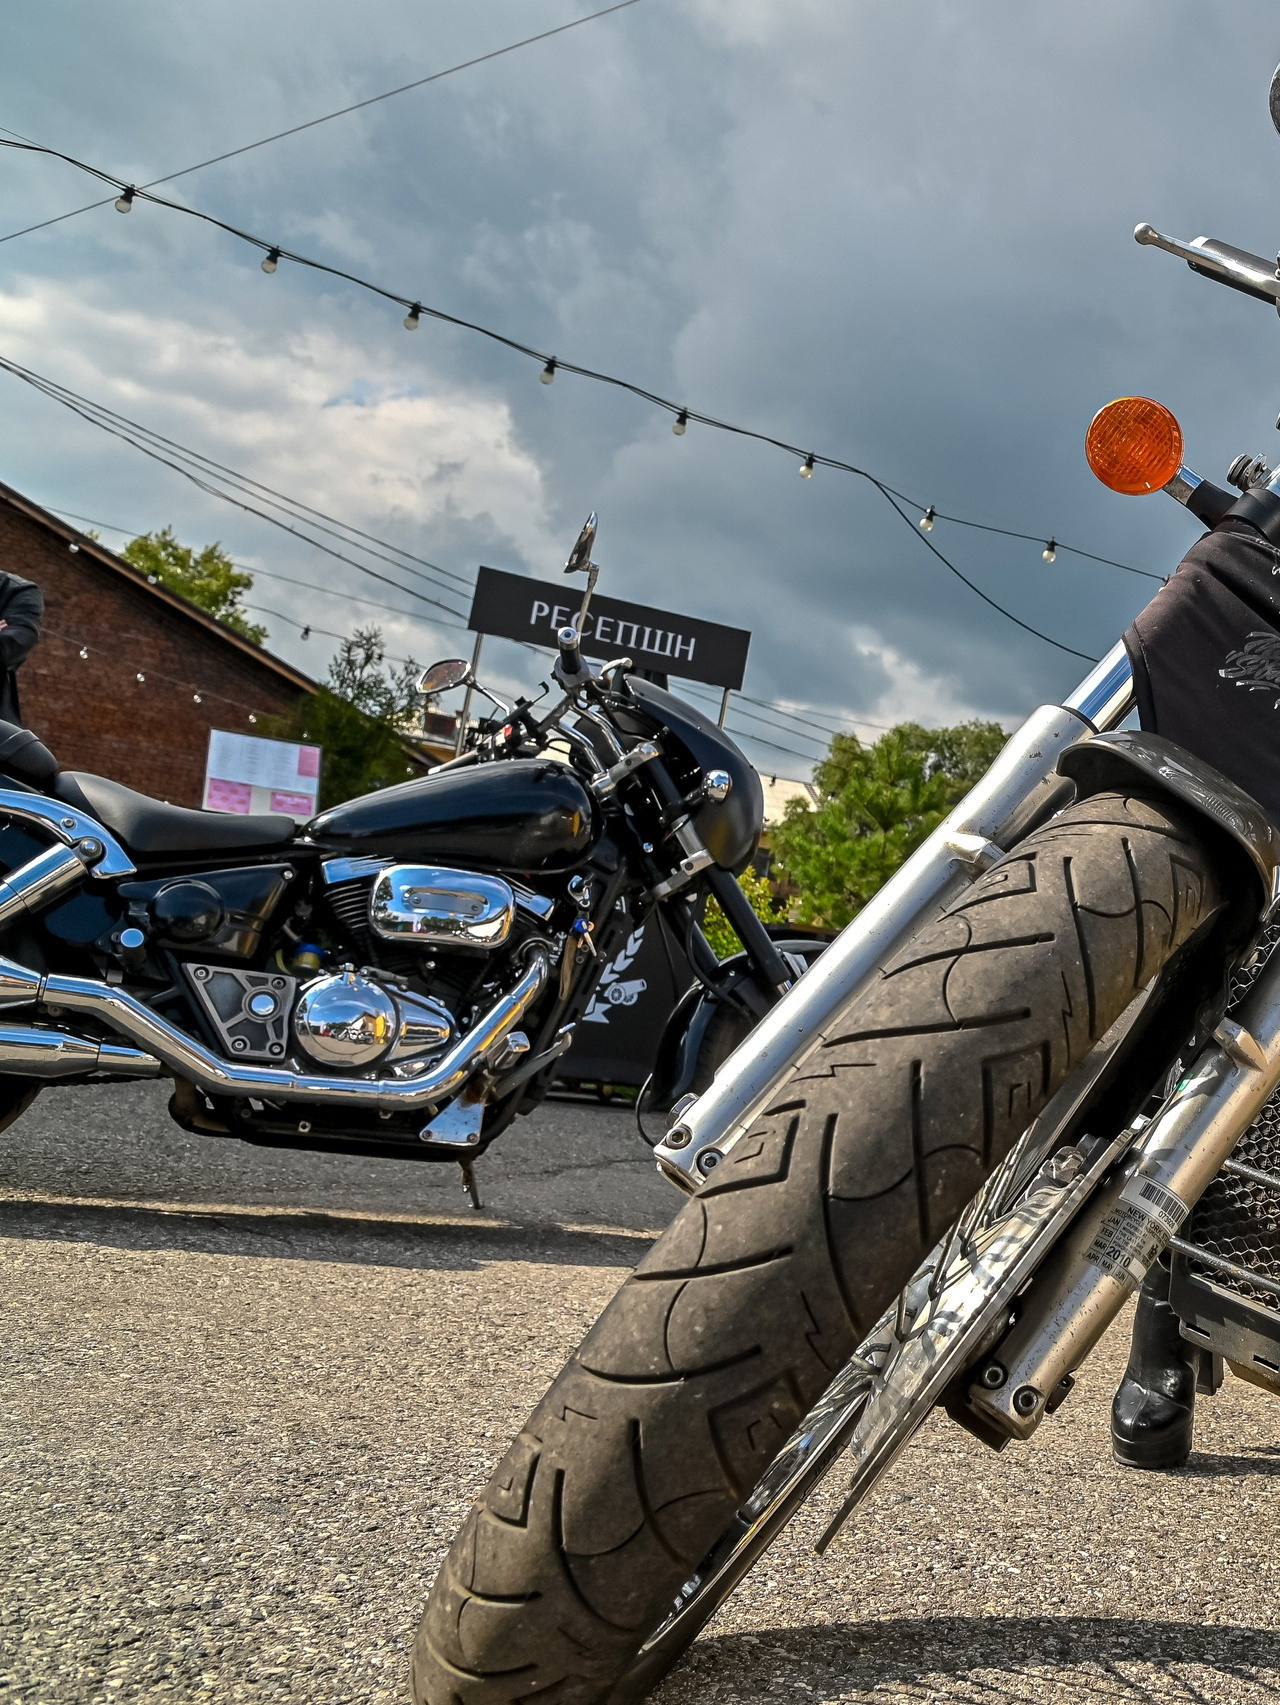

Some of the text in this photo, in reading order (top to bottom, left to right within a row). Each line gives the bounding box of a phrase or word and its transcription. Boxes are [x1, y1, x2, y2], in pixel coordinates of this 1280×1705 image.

[529, 600, 696, 662] РЕСЕПШН
[1108, 1215, 1121, 1227] JAN
[1127, 1206, 1147, 1223] NEW
[1147, 1218, 1164, 1237] YORK
[1101, 1227, 1114, 1238] FEB
[1094, 1239, 1108, 1251] MAR
[1086, 1252, 1099, 1264] APR
[1106, 1246, 1131, 1268] 2010
[1102, 1260, 1114, 1271] MAY
[1115, 1270, 1126, 1282] JUN
